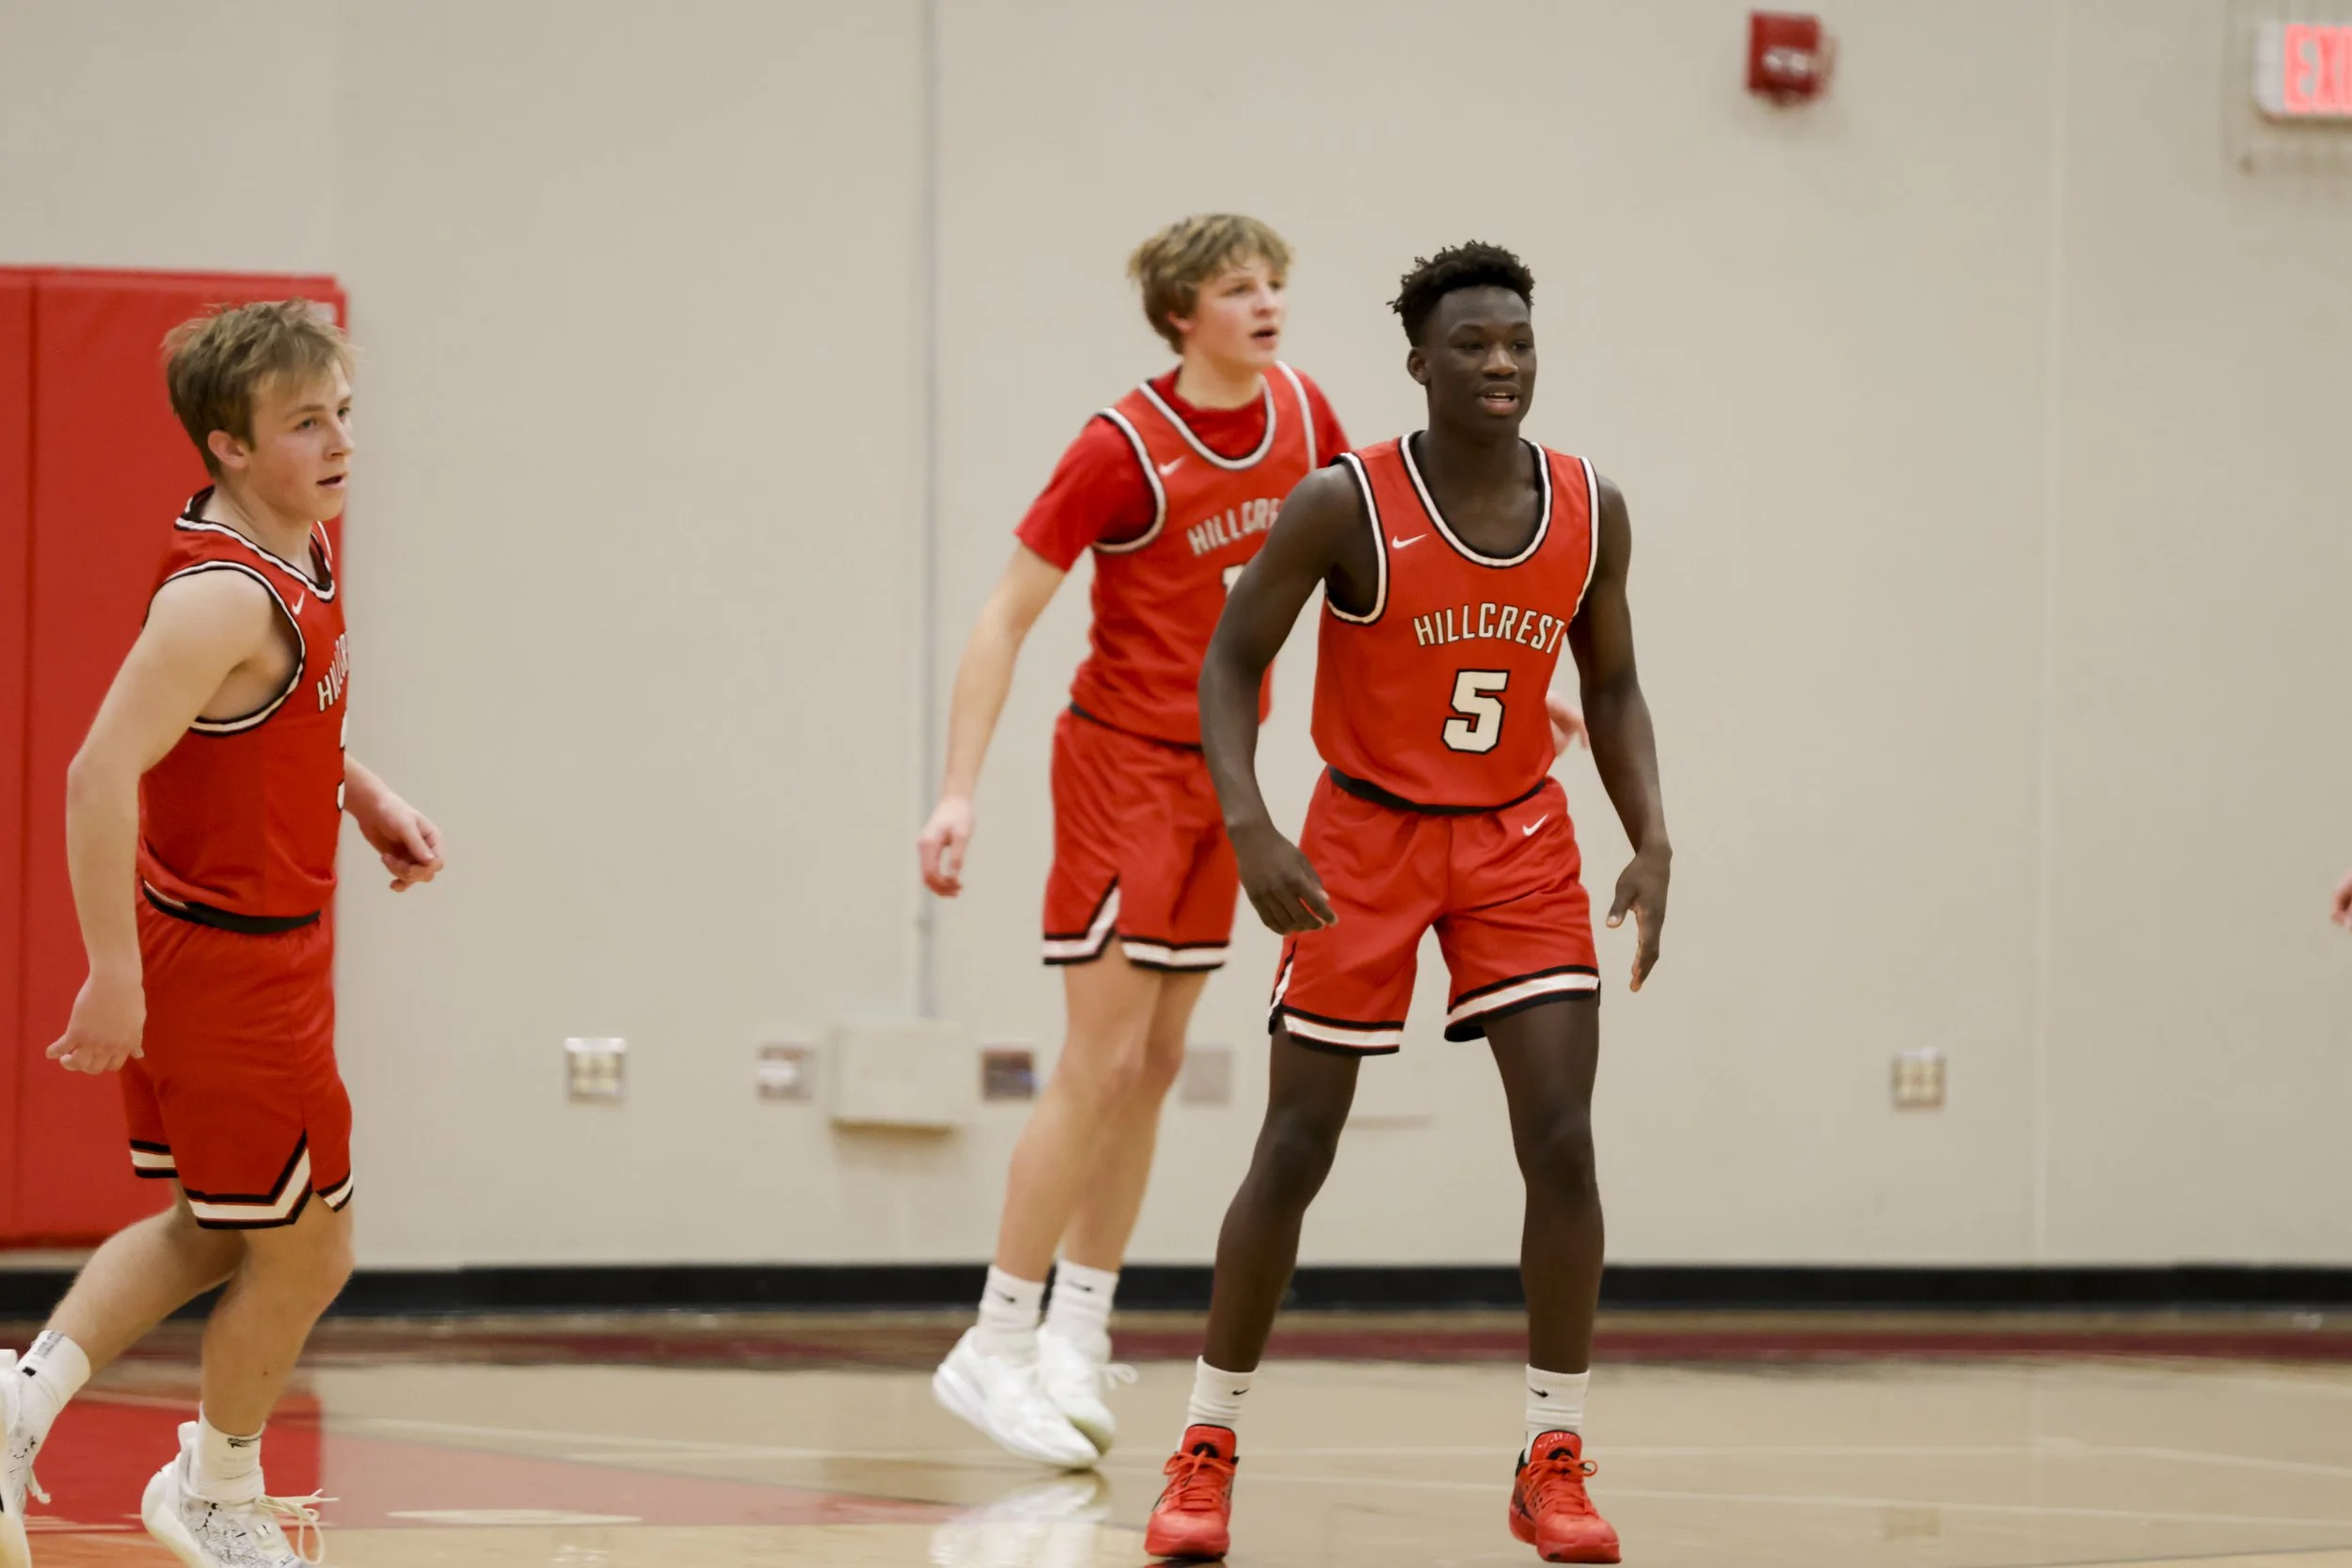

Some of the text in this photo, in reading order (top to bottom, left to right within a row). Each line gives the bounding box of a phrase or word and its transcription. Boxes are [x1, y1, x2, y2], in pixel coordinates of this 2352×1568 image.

[2284, 24, 2352, 114] EXI
[1186, 498, 1284, 556] HILLCRE
[1414, 602, 1565, 654] HILLCREST
[1441, 669, 1510, 754] 5
